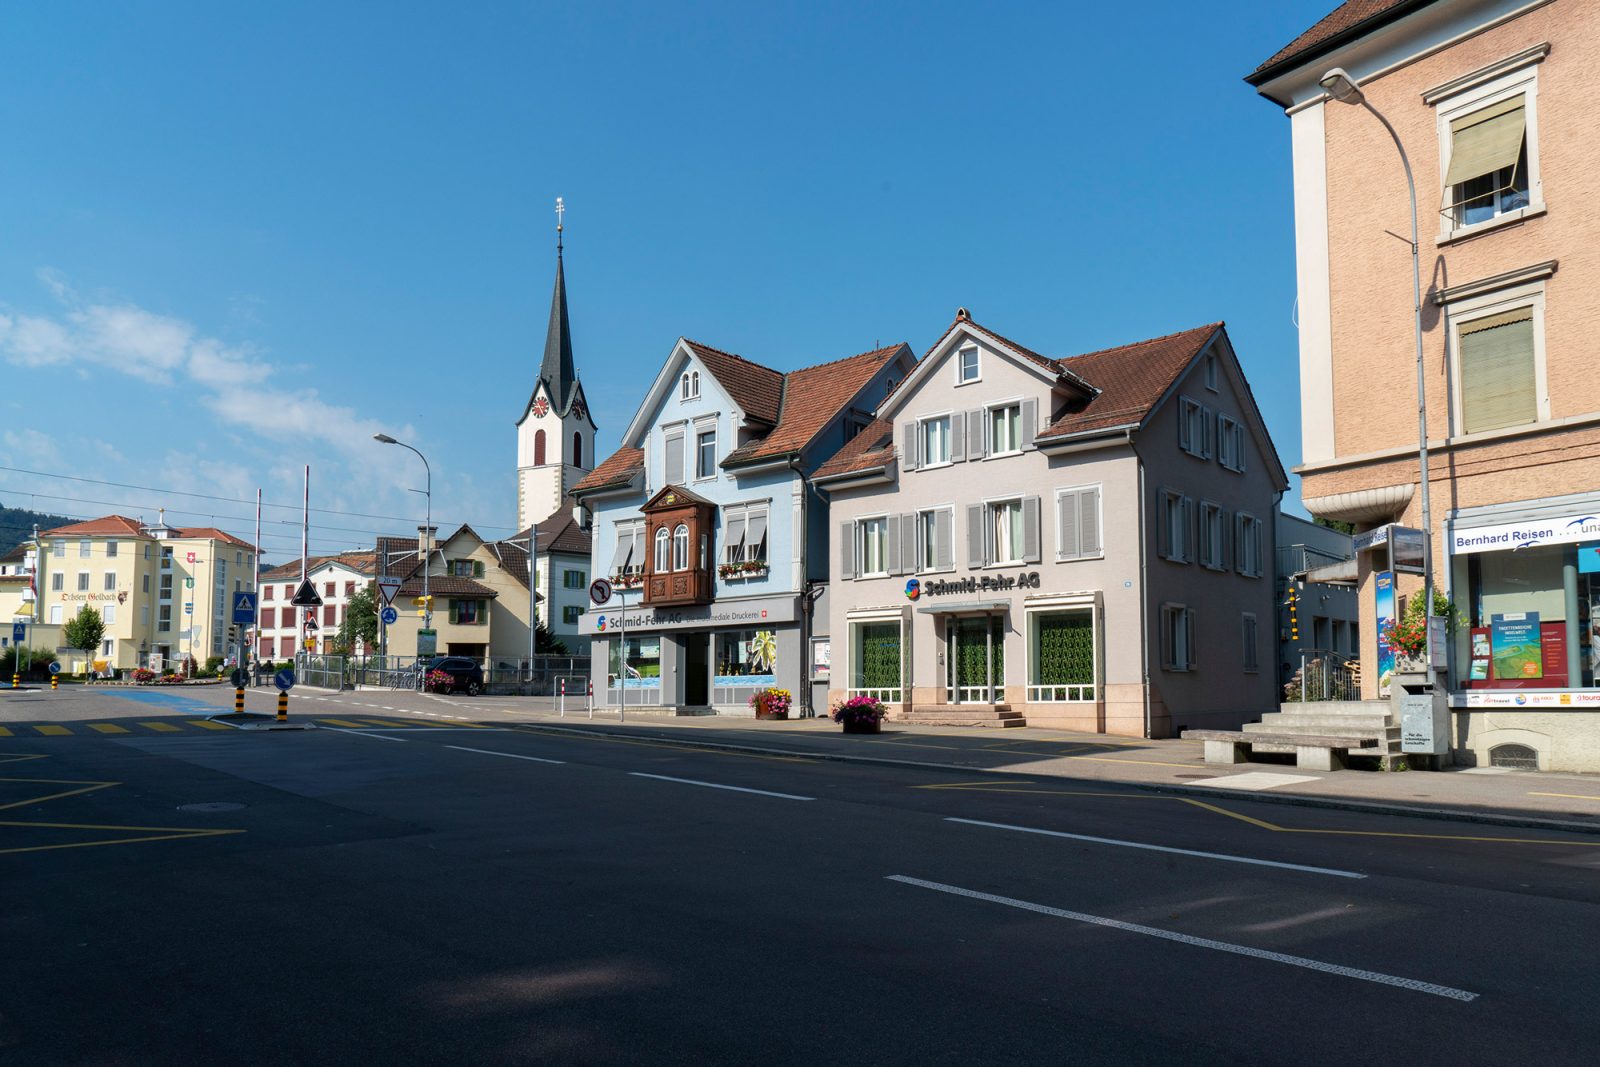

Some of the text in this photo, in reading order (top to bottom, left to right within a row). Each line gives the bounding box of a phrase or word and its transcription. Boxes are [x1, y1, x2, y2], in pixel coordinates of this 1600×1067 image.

[1456, 533, 1509, 547] Bernhard
[1512, 529, 1553, 541] Reisen
[924, 571, 1040, 596] Schmid-Fehr AG
[610, 613, 667, 628] Schmid-Fehr
[668, 612, 682, 624] AG
[731, 611, 759, 620] Druckerei
